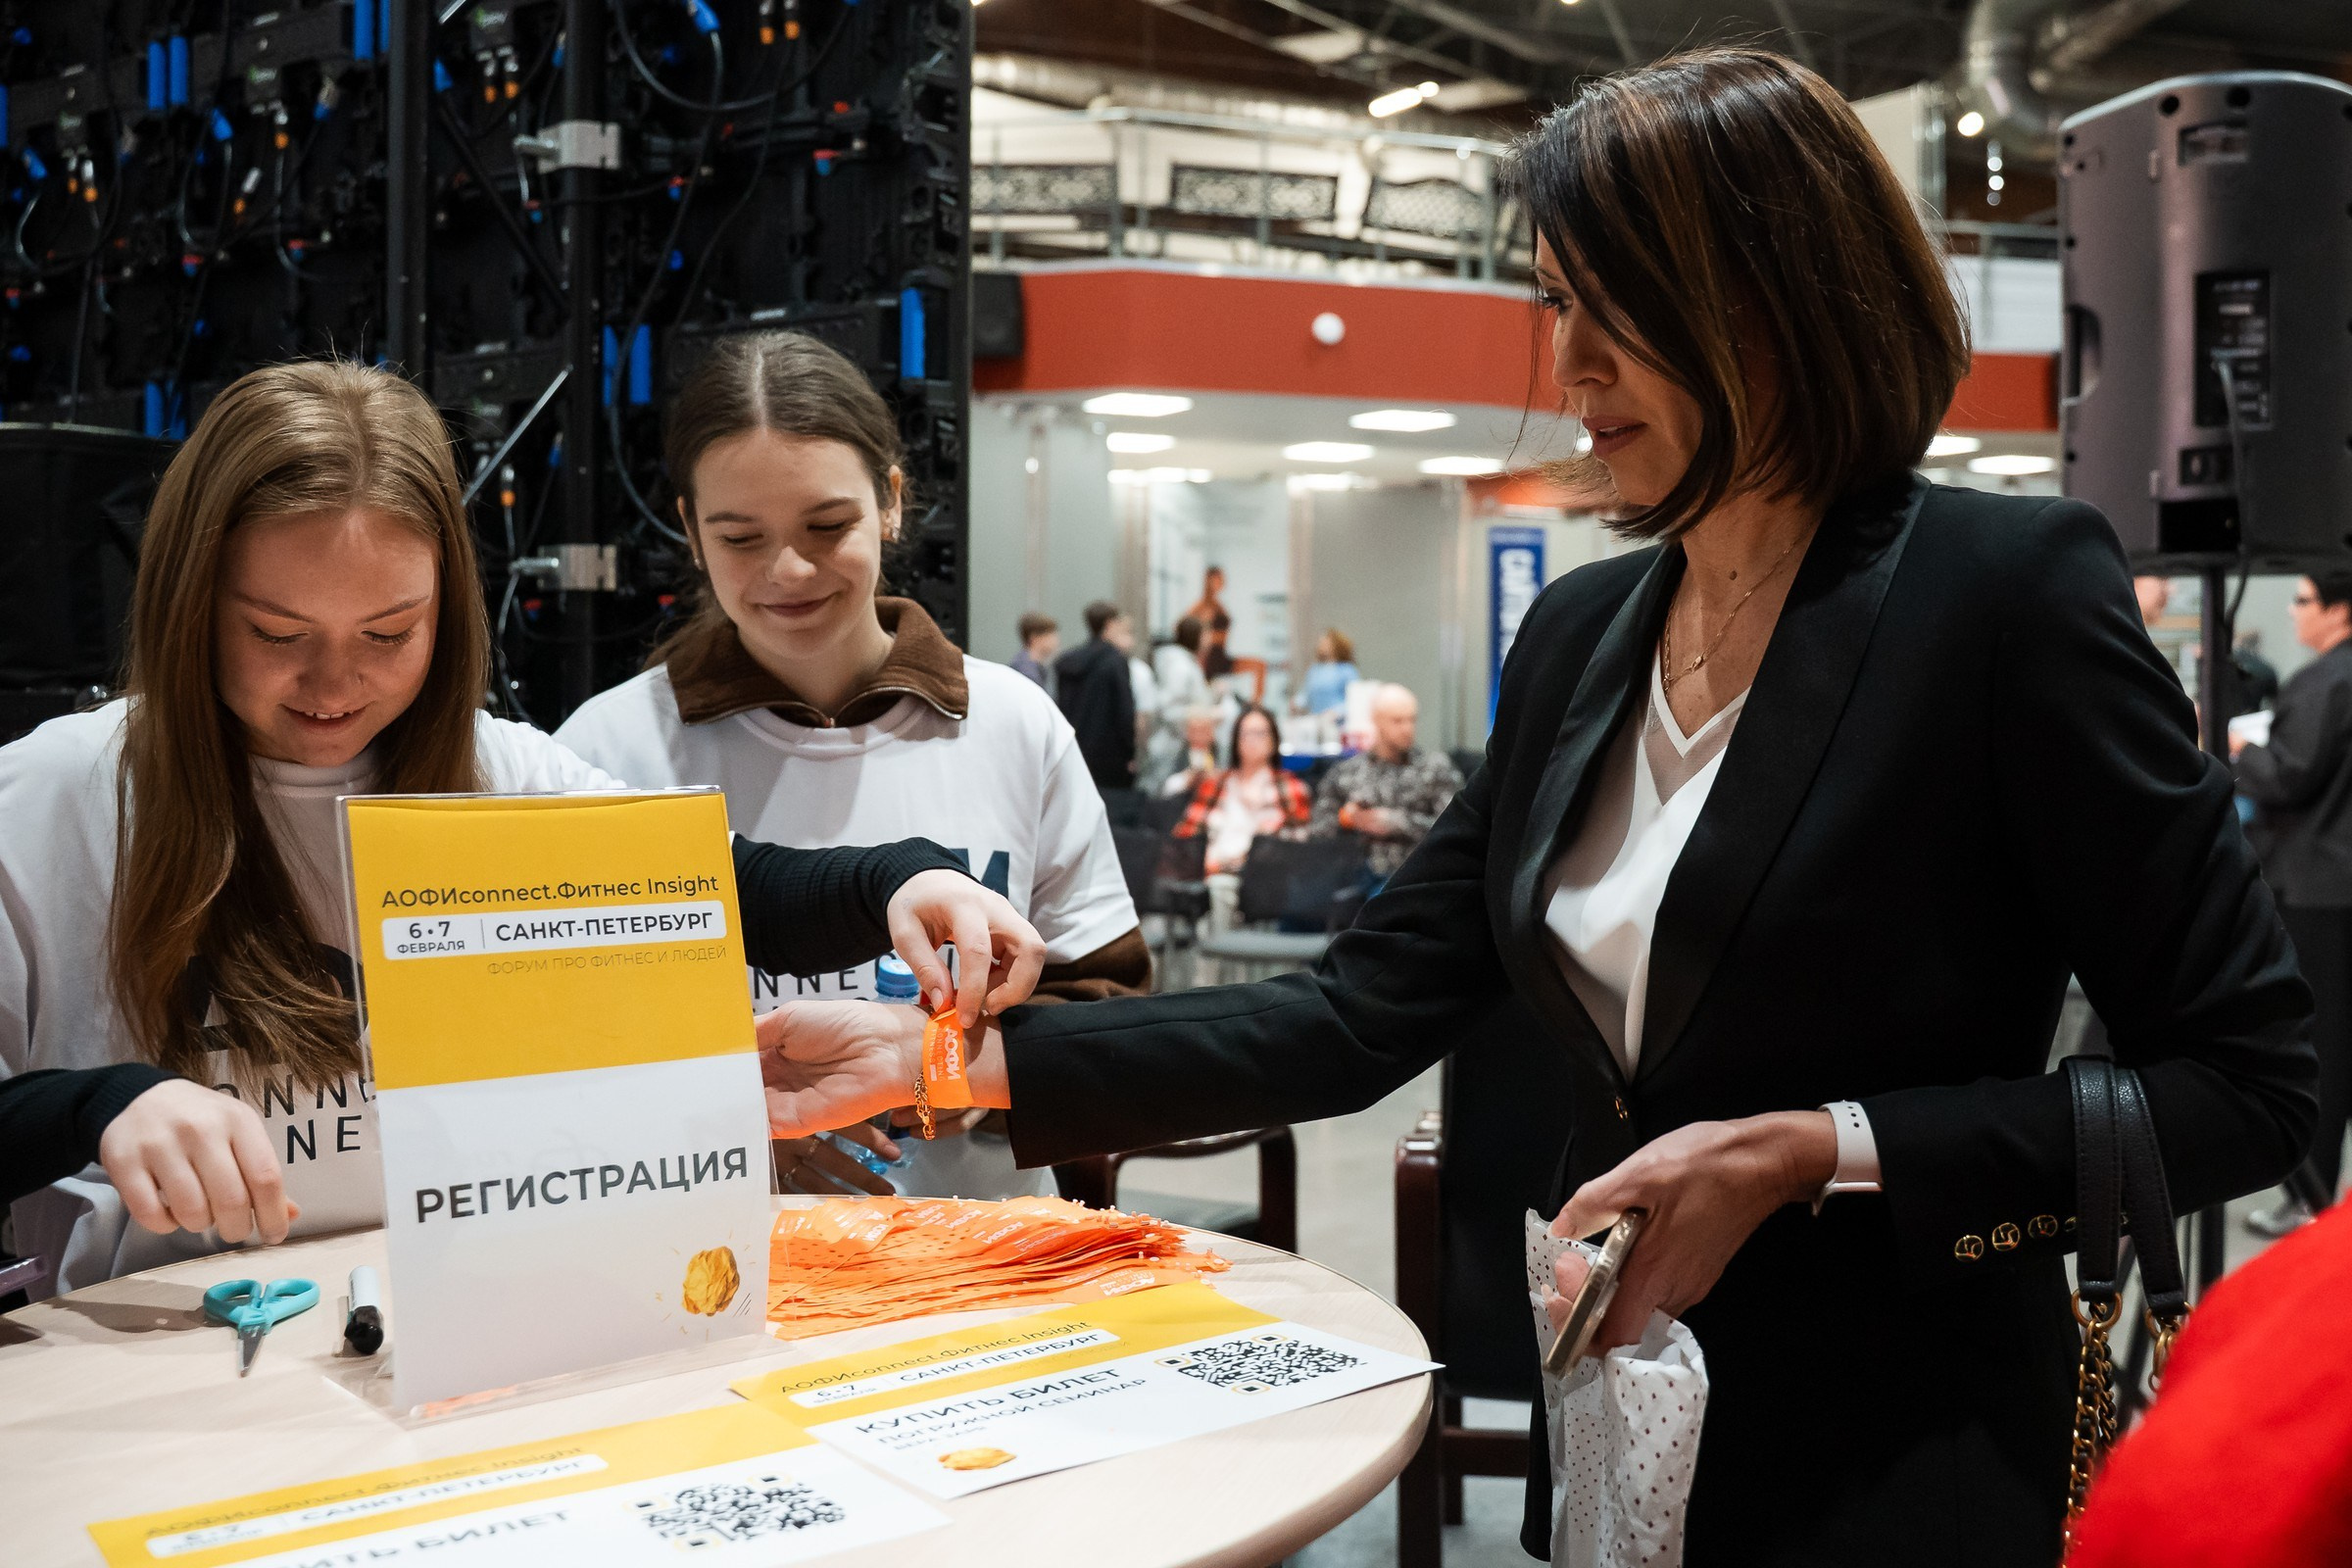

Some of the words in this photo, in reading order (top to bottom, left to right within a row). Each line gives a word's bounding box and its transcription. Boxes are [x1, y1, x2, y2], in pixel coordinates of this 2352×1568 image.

[382, 881, 642, 908] АОФИconnect.Фитнес
[648, 875, 719, 897] Insight
[495, 911, 713, 942] САНКТ-ПЕТЕРБУРГ
[397, 940, 466, 955] ФЕВРАЛЯ
[486, 958, 548, 975] ФОРУМ
[553, 956, 587, 970] ПРО
[590, 951, 654, 968] ФИТНЕС
[658, 949, 668, 963] И
[672, 945, 727, 962] ЛЮДЕЙ
[416, 1146, 749, 1224] РЕГИСТРАЦИЯ
[1022, 1321, 1093, 1341] Insight
[899, 1333, 1100, 1383] САНКТ-ПЕТЕРБУРГ
[855, 1396, 1005, 1434] КУПИТЬ
[1008, 1368, 1121, 1399] БИЛЕТ
[878, 1403, 1035, 1444] ПОГРУЖНОЙ
[1038, 1378, 1147, 1407] СЕМИНАР
[416, 1509, 569, 1549] БИЛЕТ
